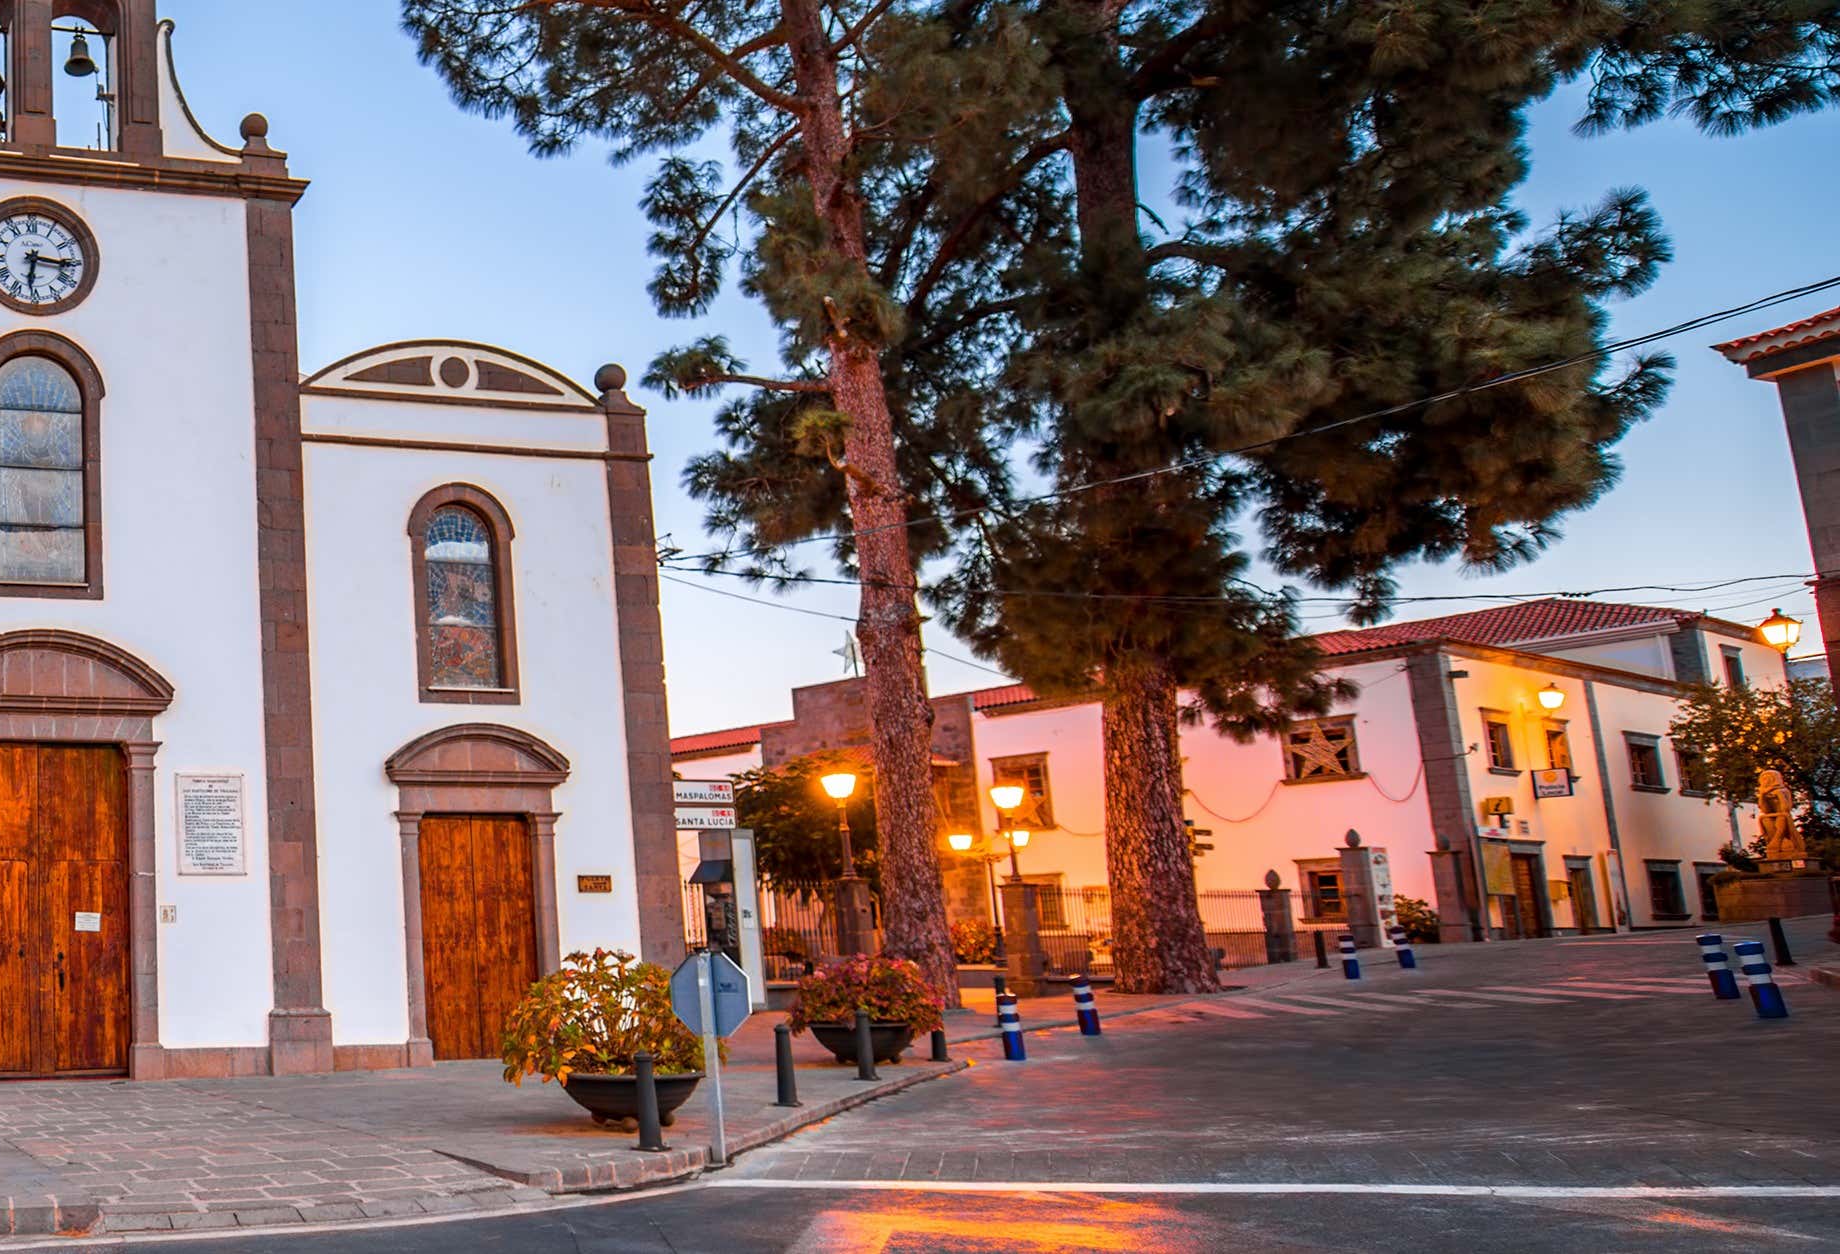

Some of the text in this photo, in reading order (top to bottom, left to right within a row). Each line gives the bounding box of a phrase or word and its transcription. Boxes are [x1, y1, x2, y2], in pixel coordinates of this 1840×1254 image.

[25, 222, 38, 234] XII
[676, 792, 732, 801] MASPALOMAS
[676, 818, 705, 826] SANTA
